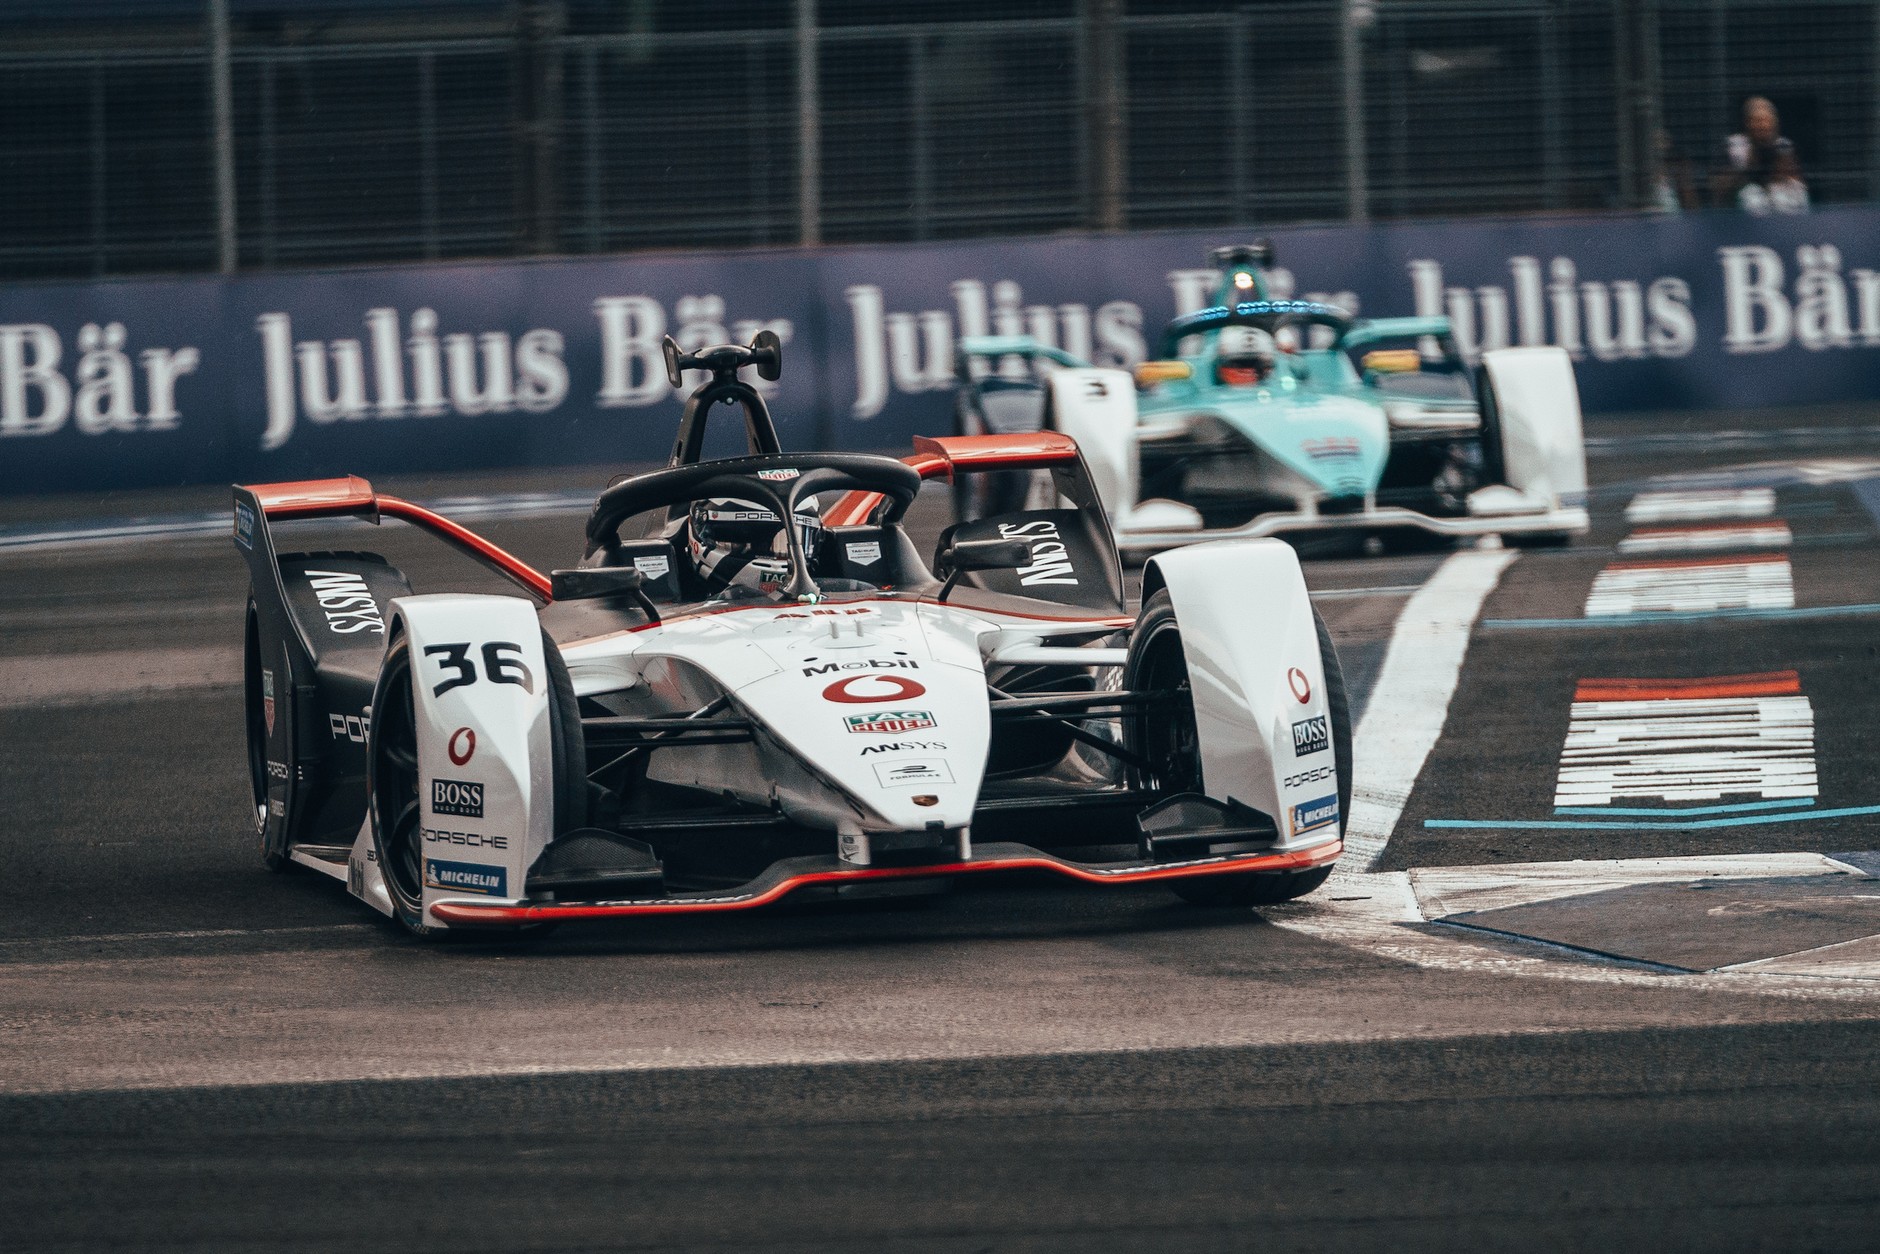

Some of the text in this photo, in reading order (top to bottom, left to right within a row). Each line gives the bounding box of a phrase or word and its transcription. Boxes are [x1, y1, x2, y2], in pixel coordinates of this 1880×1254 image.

[0, 322, 201, 437] Bär
[257, 306, 570, 452] Julius
[304, 570, 386, 634] ANSYS
[423, 640, 534, 698] 36
[802, 659, 920, 678] Mobil
[853, 711, 925, 724] TAG
[853, 719, 932, 732] HEUER
[1294, 719, 1327, 746] BOSS
[861, 742, 947, 755] ANSYS
[434, 782, 481, 807] BOSS
[441, 871, 500, 887] MICHELIN
